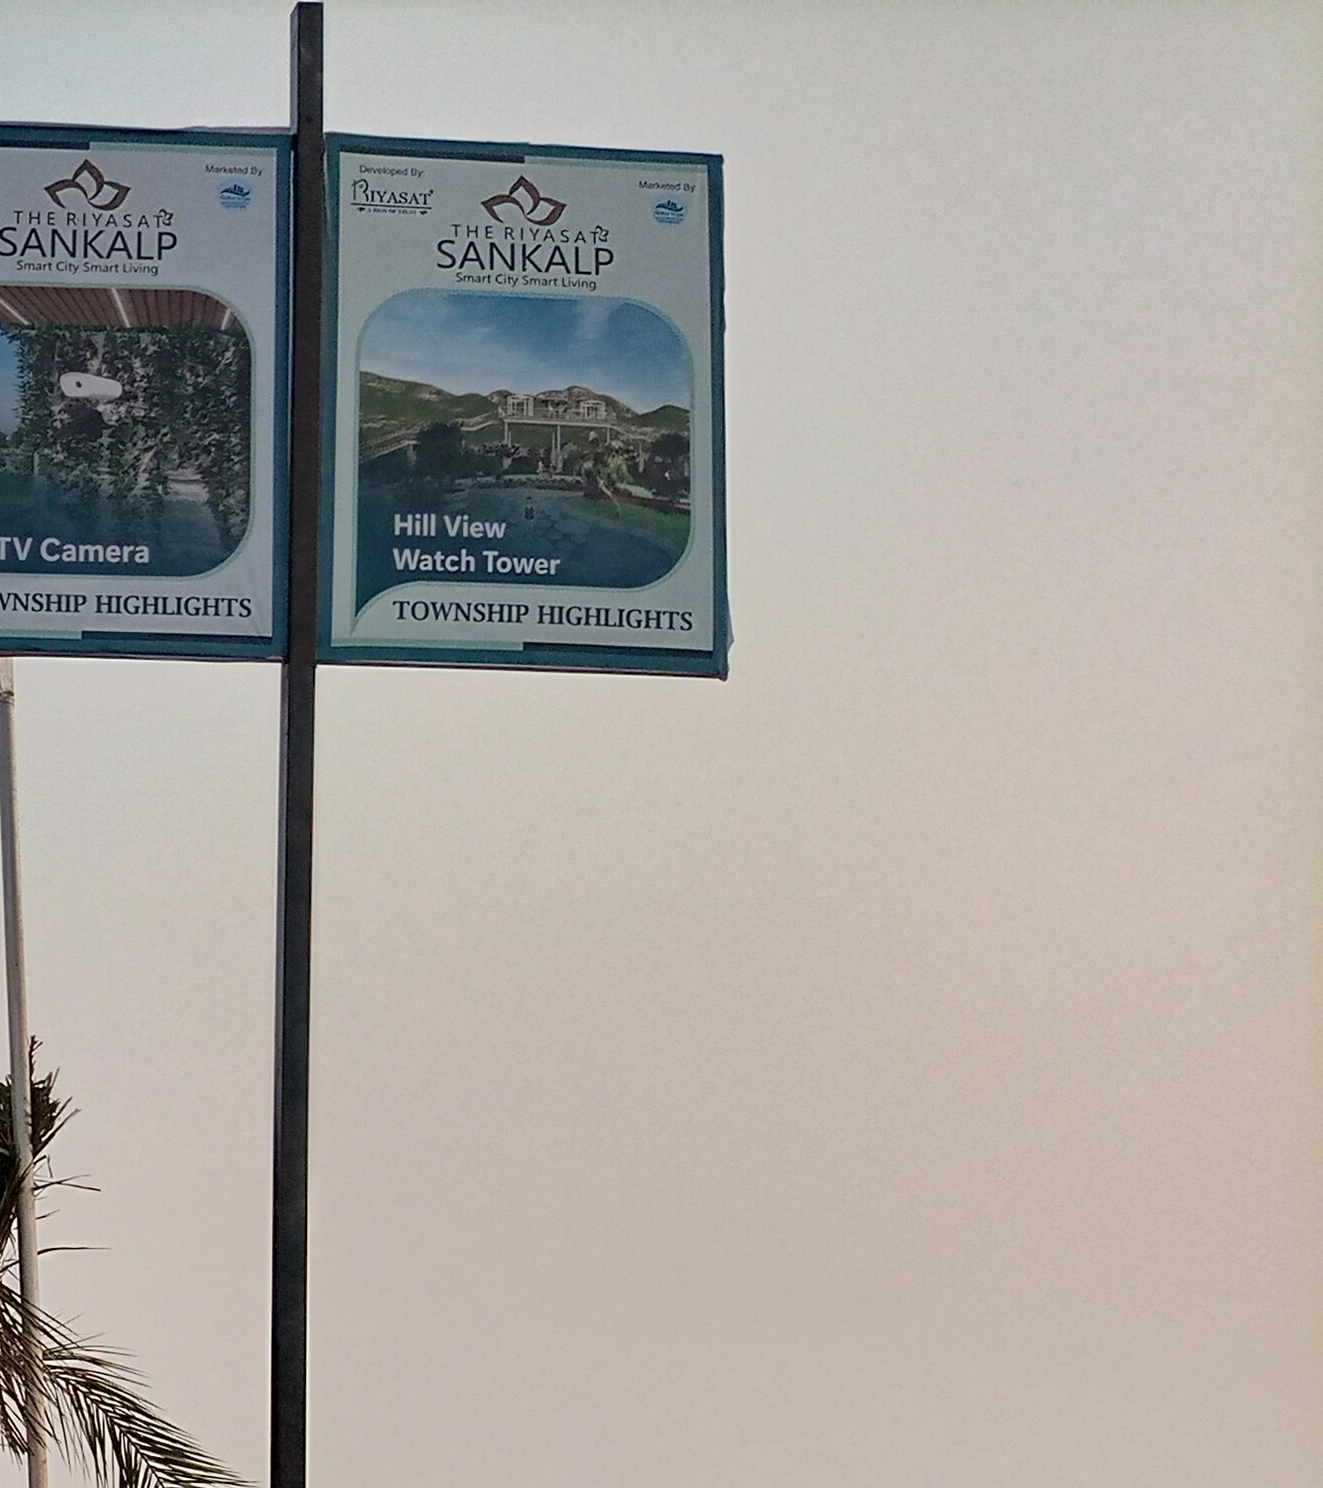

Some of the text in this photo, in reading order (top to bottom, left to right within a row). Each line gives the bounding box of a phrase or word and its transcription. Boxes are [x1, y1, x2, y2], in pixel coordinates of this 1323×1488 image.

[205, 164, 249, 175] Marketed
[359, 164, 408, 177] Developed
[351, 178, 431, 205] RIYASAT
[638, 180, 681, 191] Marketed
[13, 210, 164, 228] THE RIYASAT
[451, 223, 600, 245] THE RIYASAT
[16, 259, 159, 277] Smart City Smart Living
[436, 239, 615, 276] SANKALP
[455, 272, 597, 292] Smart City Smart Living
[393, 513, 507, 539] Hill View
[40, 537, 150, 564] Camera
[392, 548, 561, 575] Watch Tower
[94, 594, 253, 618] HIGHLIGHTS
[392, 600, 694, 631] TOWNSHIP HIGHLIGHTS
